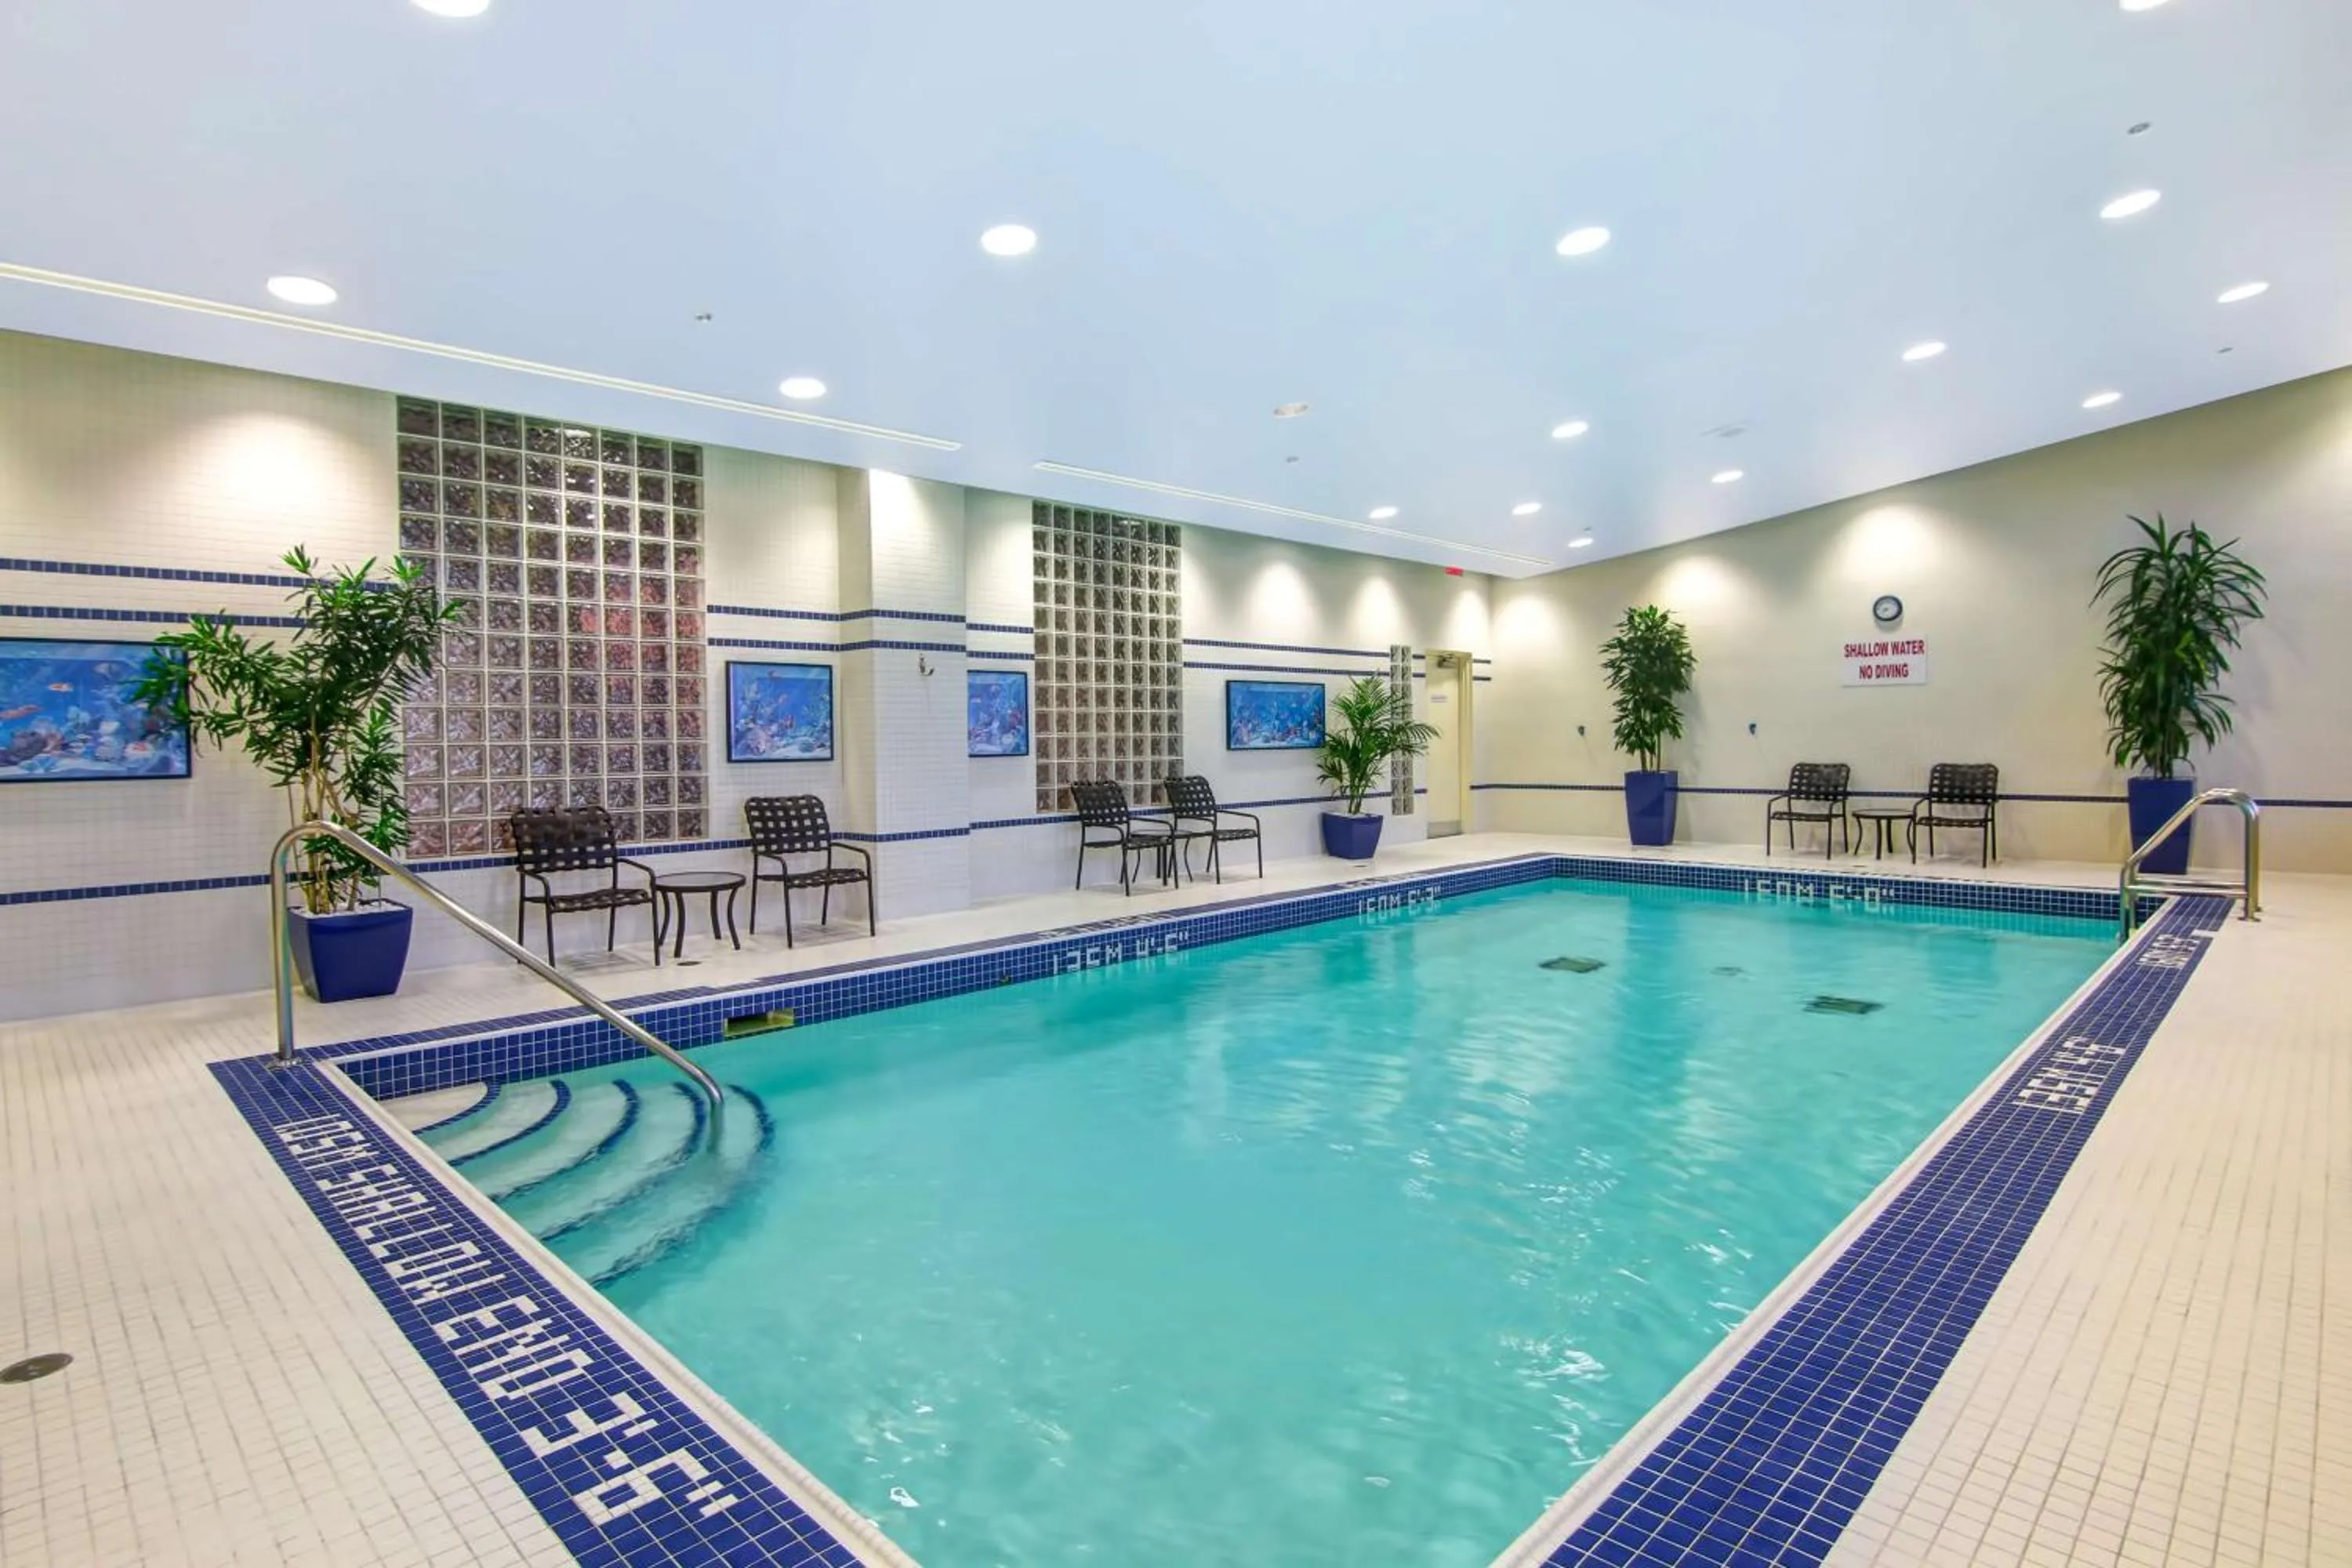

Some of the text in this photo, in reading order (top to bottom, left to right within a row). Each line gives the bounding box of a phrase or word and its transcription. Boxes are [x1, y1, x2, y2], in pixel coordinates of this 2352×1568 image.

[1844, 640, 1925, 658] SHALLOW WATER
[1859, 663, 1908, 679] NO DIVING
[315, 1163, 506, 1305] SHALLOW
[433, 1295, 593, 1399] END
